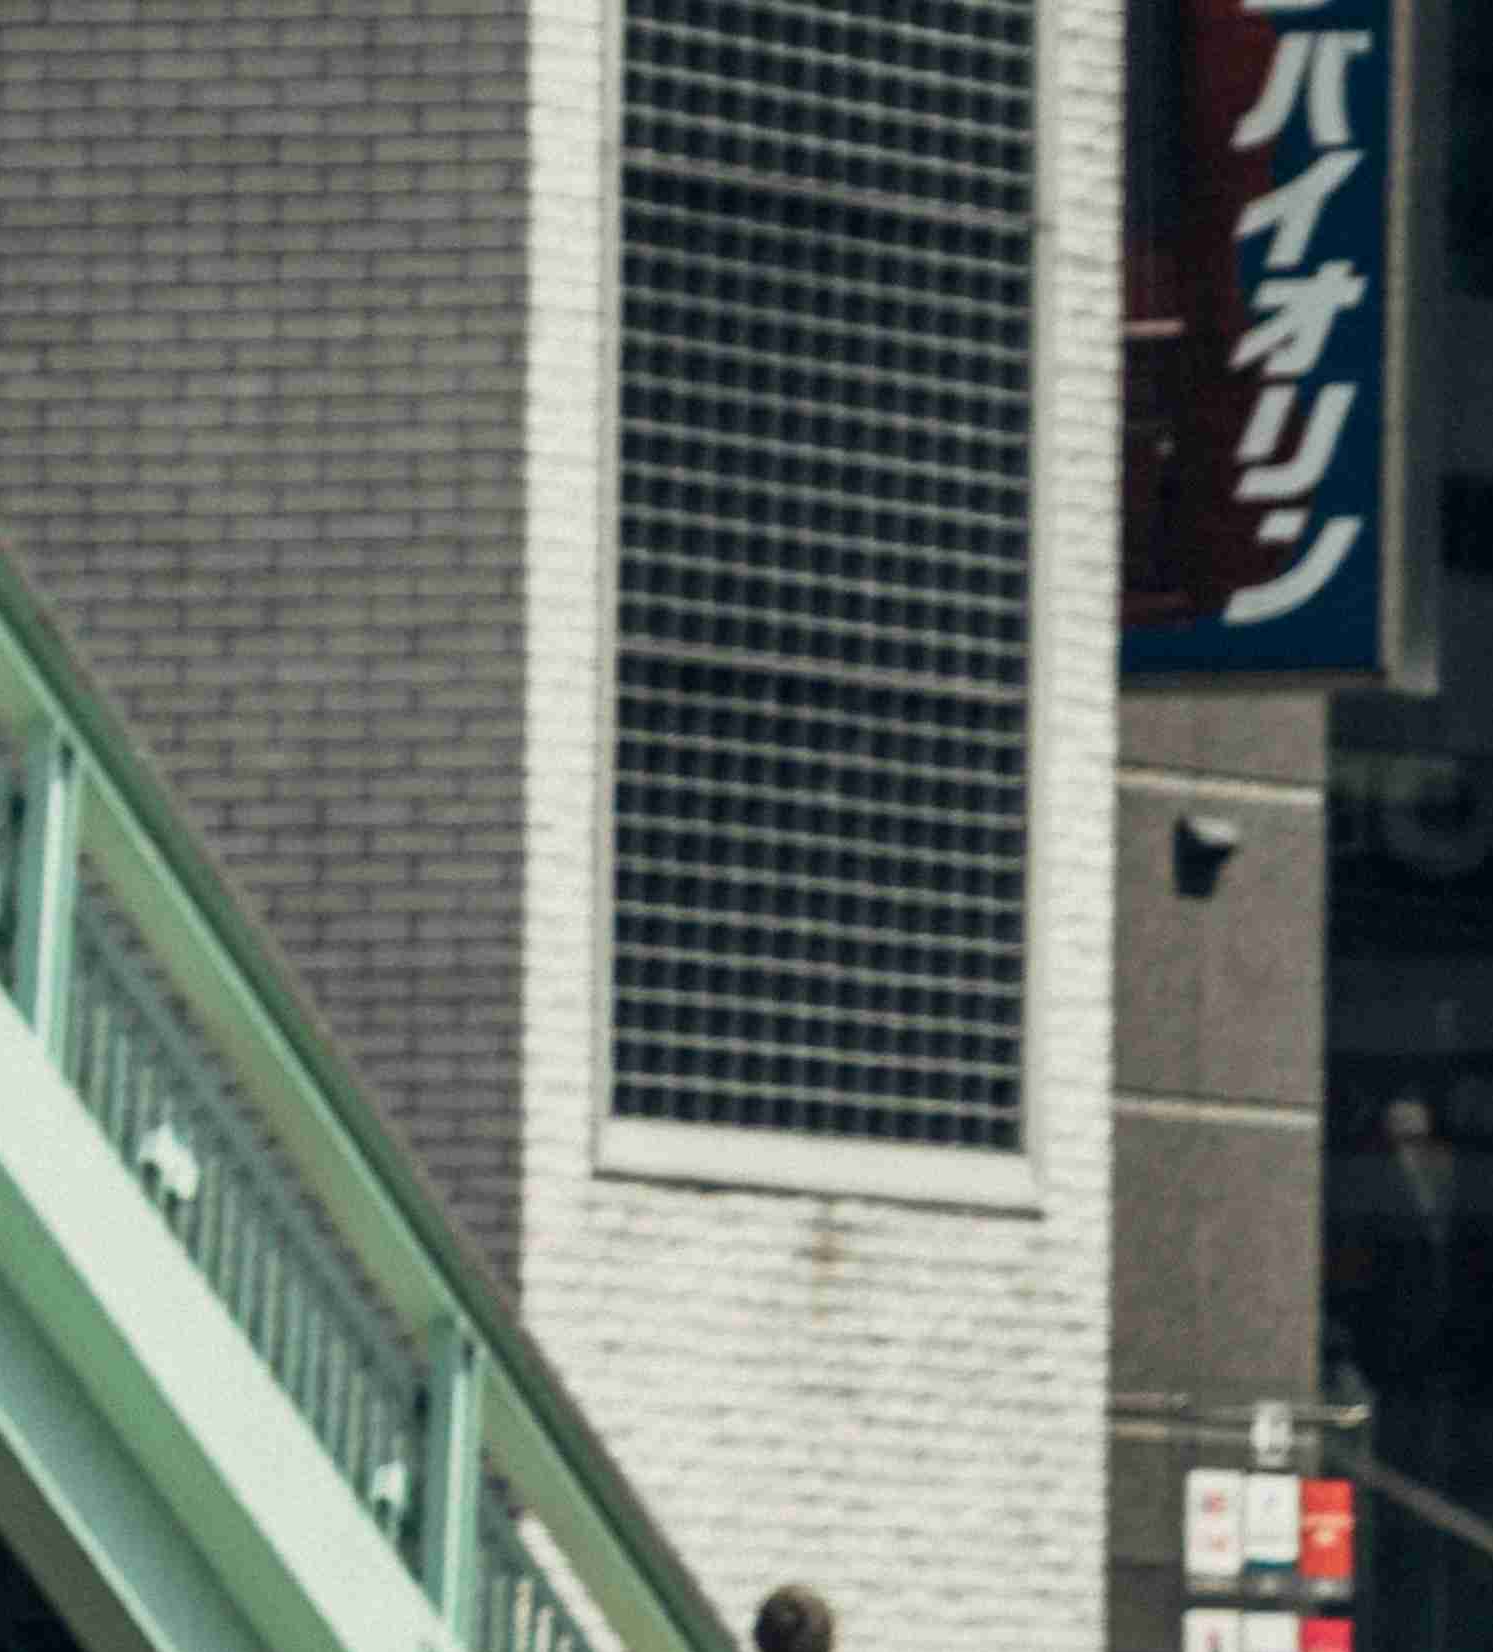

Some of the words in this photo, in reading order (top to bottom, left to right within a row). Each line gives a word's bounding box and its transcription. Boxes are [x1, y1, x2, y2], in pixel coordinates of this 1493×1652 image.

[1221, 0, 1374, 626] バイオリン
